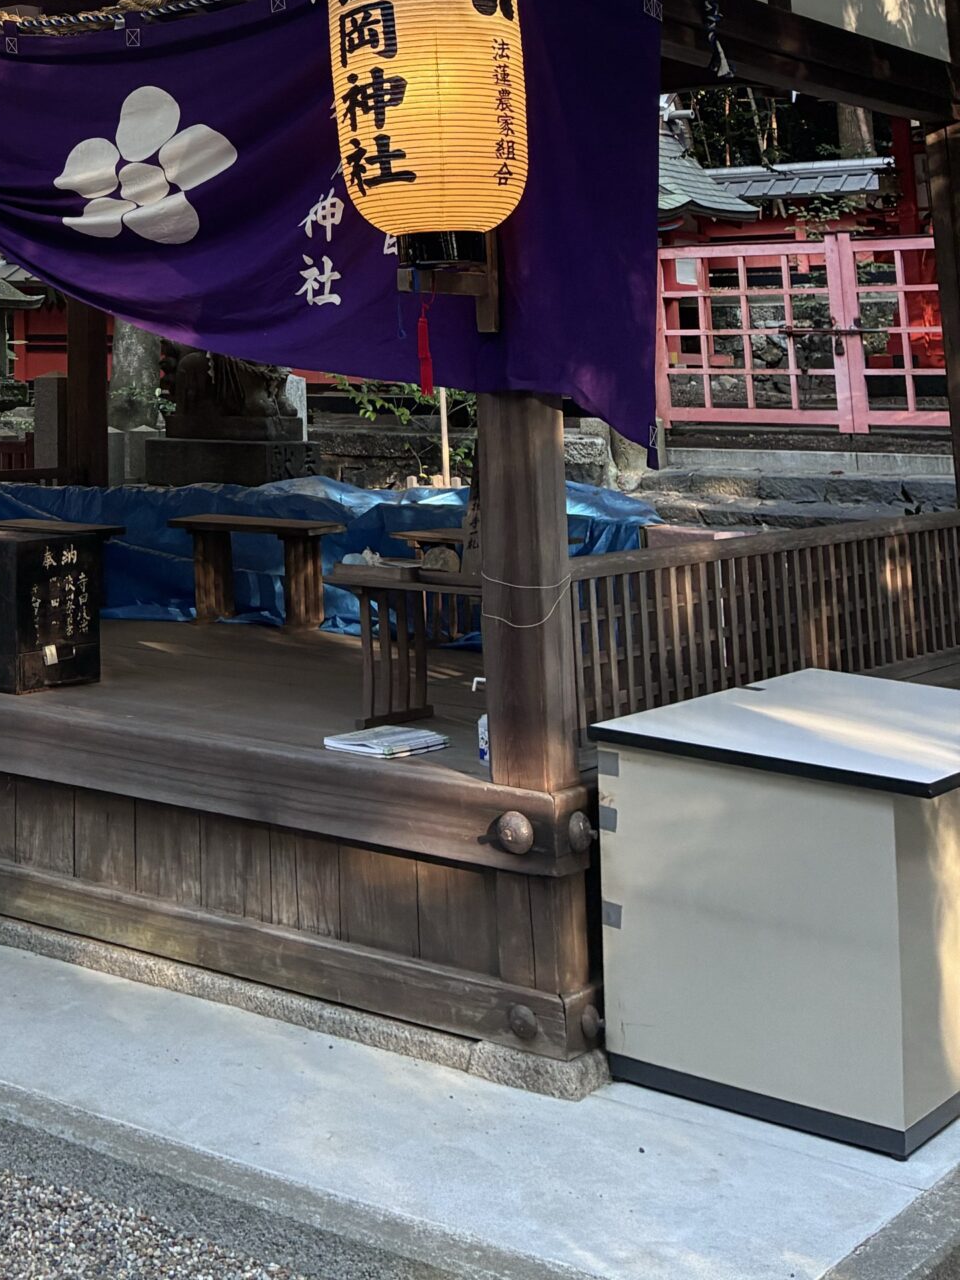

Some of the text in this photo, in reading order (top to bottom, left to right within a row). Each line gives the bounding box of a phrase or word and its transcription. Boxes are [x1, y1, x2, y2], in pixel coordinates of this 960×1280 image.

[491, 37, 517, 187] 法蓮農家組合
[295, 160, 345, 306] 神社
